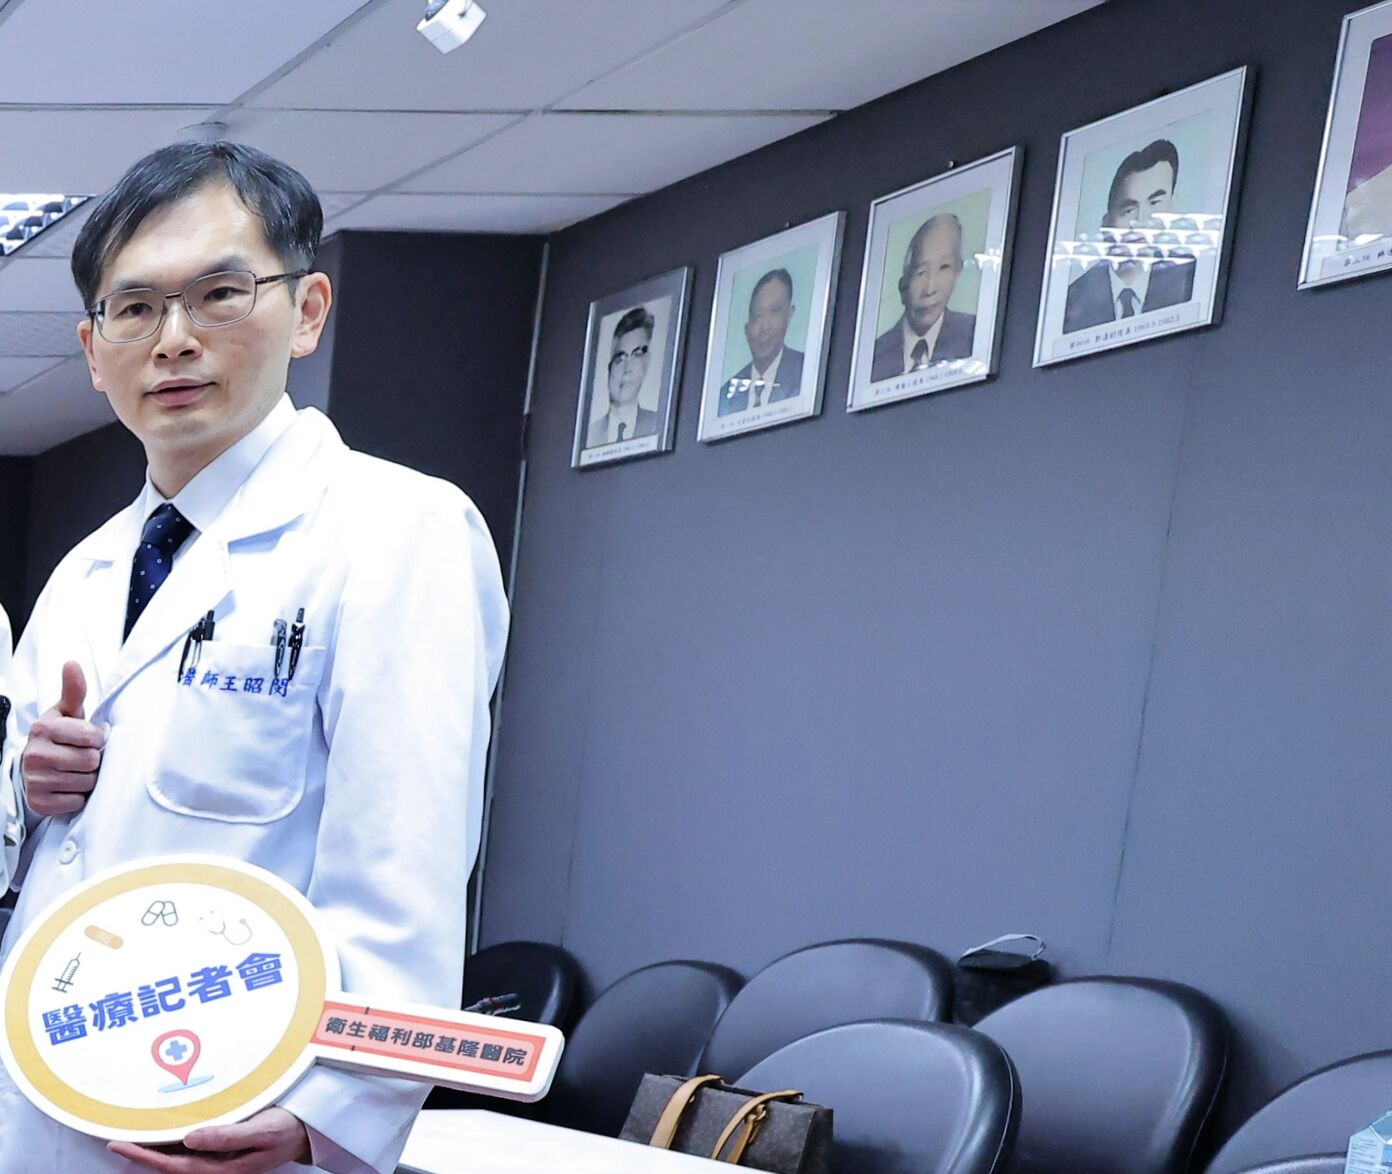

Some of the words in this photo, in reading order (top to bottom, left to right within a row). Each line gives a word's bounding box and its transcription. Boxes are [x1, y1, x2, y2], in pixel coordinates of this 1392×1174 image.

[41, 951, 285, 1046] 醫療記者會
[325, 1016, 528, 1066] 衛生福利部基隆醫院
